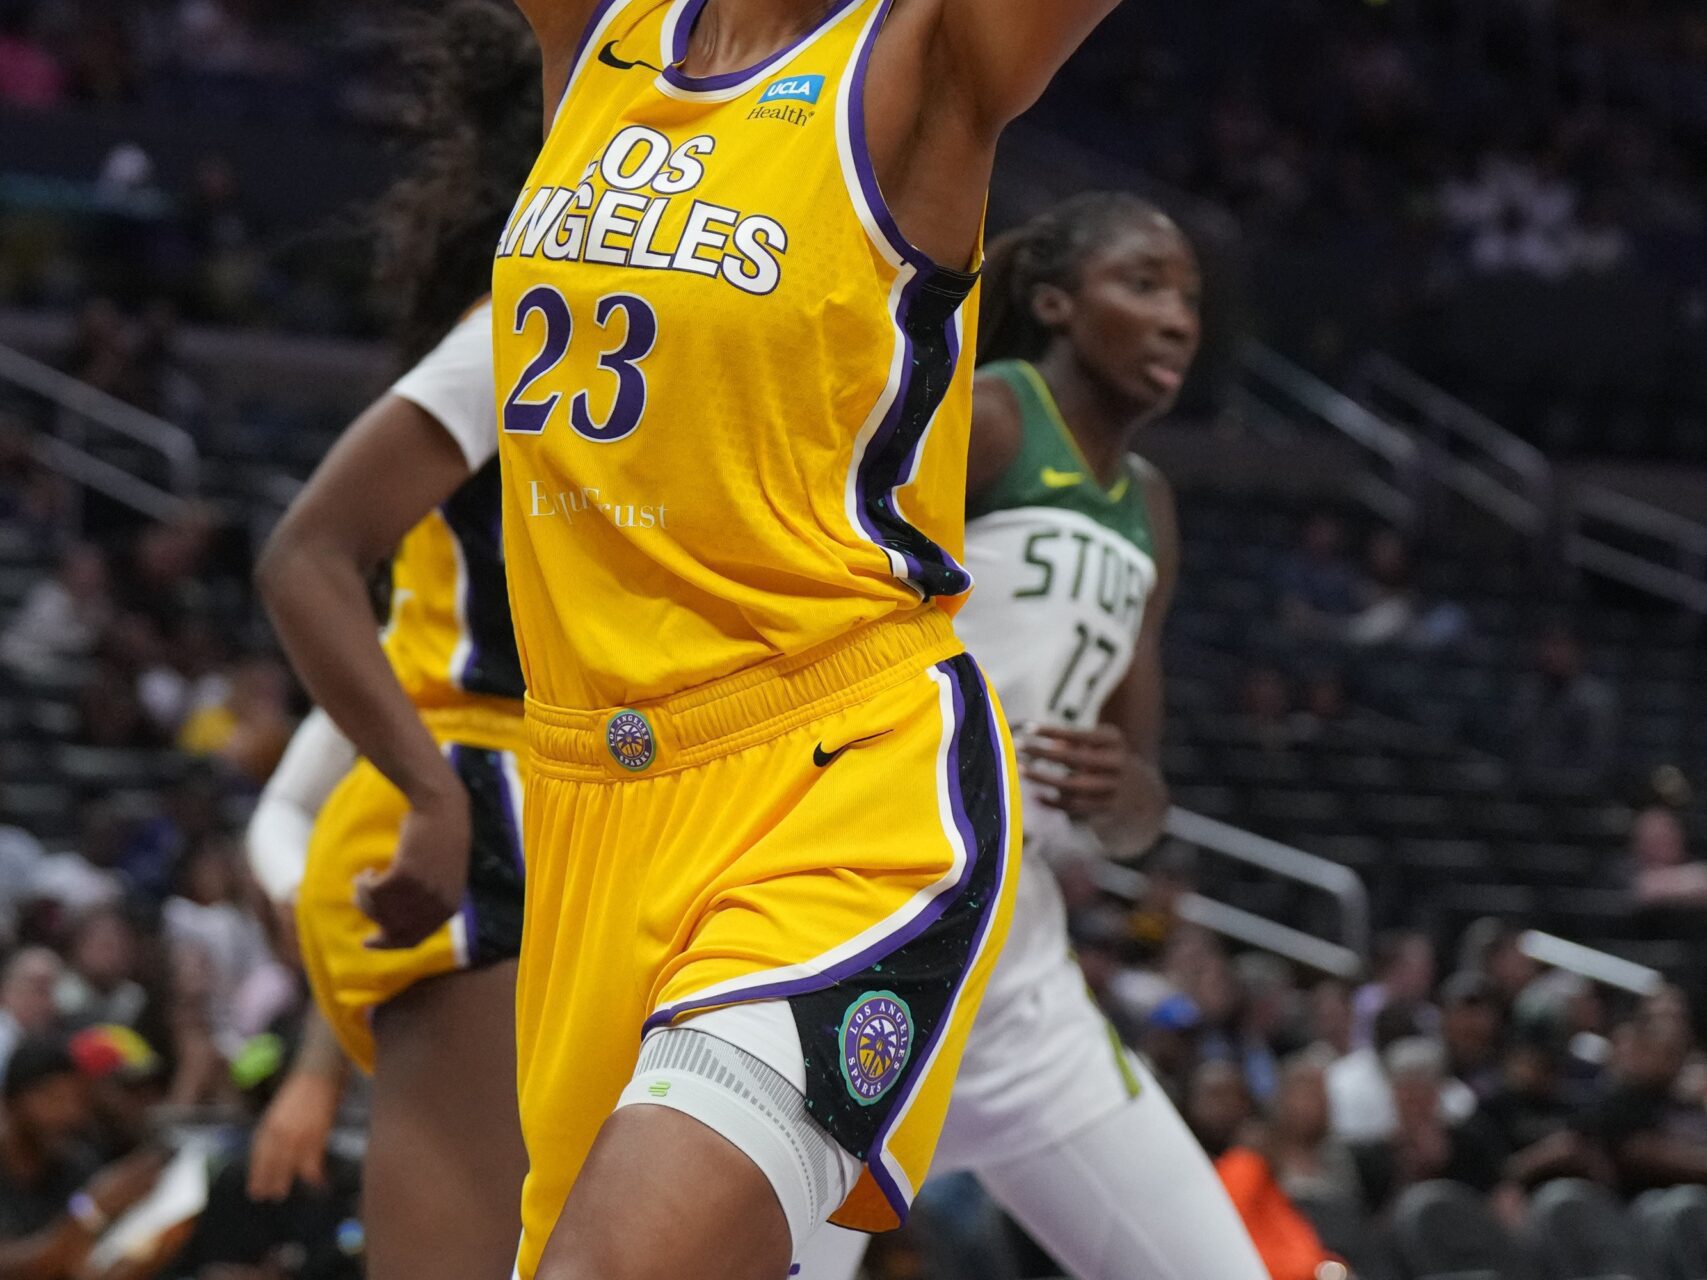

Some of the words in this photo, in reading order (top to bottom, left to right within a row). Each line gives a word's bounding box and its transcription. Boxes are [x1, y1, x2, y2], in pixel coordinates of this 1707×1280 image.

[767, 80, 811, 97] UCLA
[502, 283, 659, 443] 23
[616, 715, 650, 740] ANGELES
[620, 750, 650, 767] SPARKS
[850, 1005, 872, 1035] LOS
[879, 1001, 908, 1070] ANGELES
[848, 1057, 882, 1096] SPARKS
